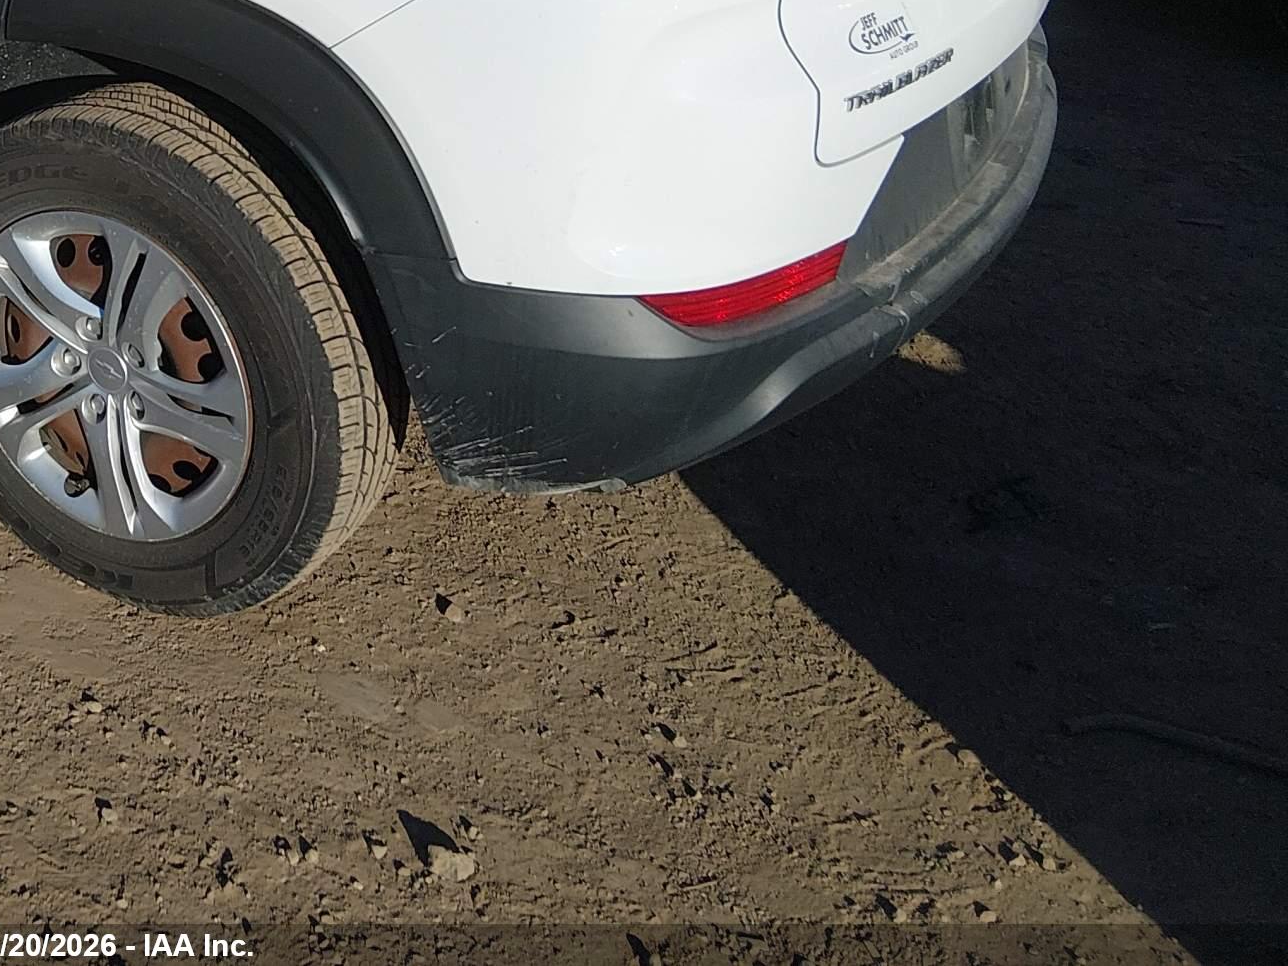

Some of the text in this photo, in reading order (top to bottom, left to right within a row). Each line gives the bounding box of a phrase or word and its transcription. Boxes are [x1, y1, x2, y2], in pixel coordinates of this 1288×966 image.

[859, 12, 878, 31] JEFF
[861, 15, 909, 51] SCHMITT
[889, 40, 919, 60] AUTO GROUP
[843, 47, 954, 113] TRAILBLAZER
